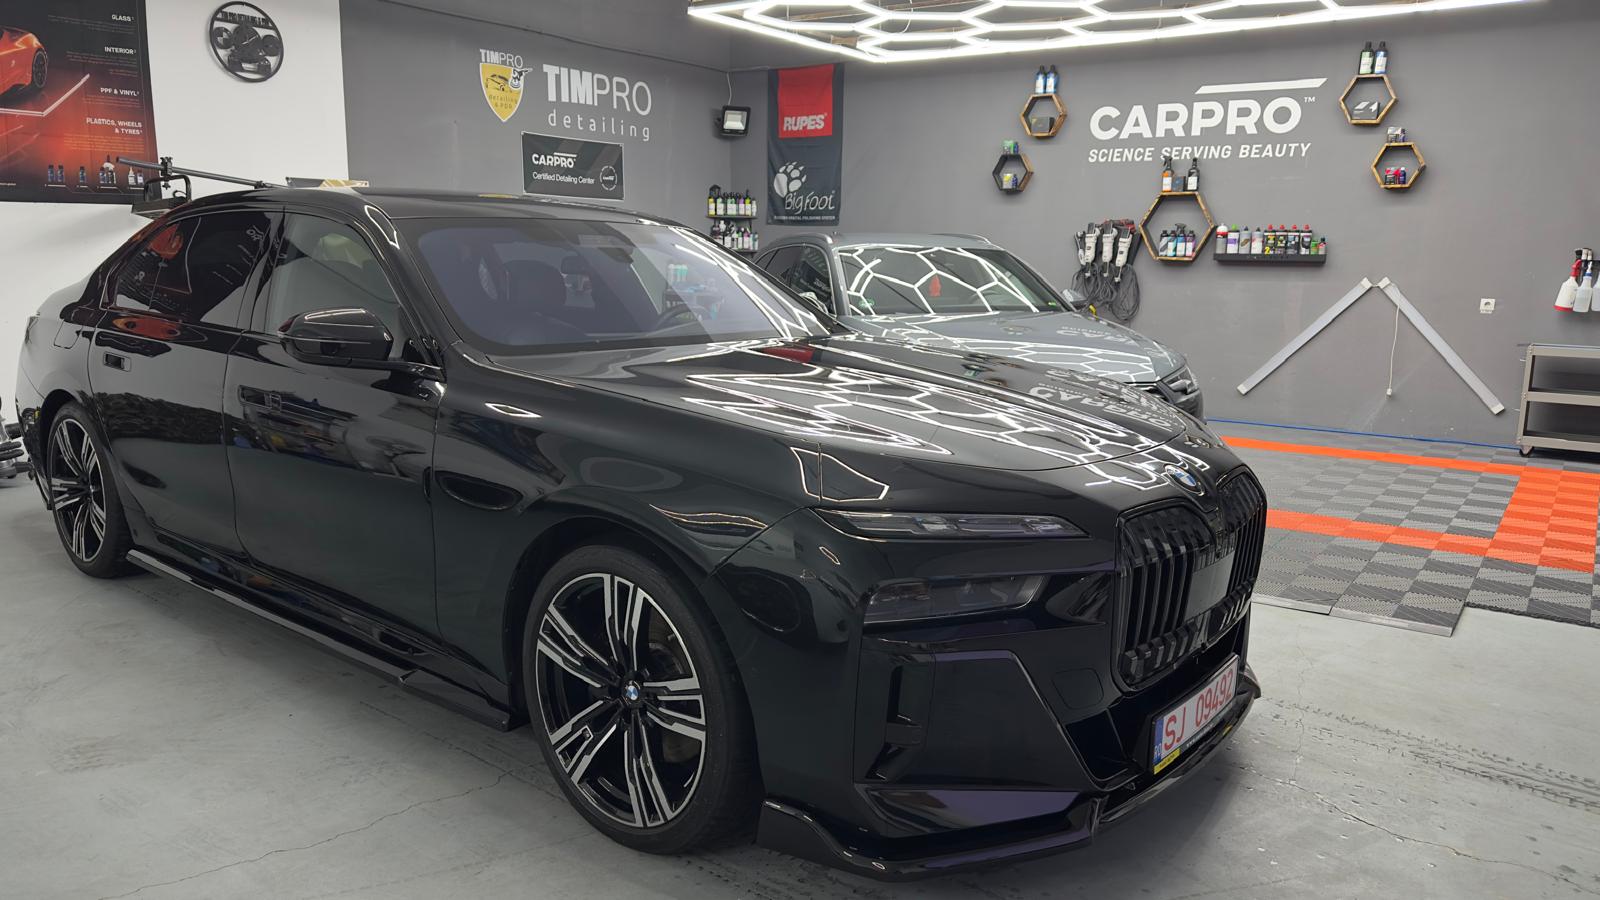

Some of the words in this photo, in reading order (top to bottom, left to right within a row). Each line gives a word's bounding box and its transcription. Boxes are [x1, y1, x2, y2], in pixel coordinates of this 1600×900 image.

[104, 46, 134, 54] INTERIOR
[480, 49, 523, 69] TIMPRO
[119, 89, 138, 97] VINYL
[543, 64, 652, 115] TIMPRO
[117, 120, 142, 128] WHEELS
[548, 109, 650, 142] detailing
[783, 114, 825, 132] RUPES
[1089, 97, 1302, 140] CARPRO
[532, 153, 575, 168] CARPRO
[1088, 147, 1155, 162] SCIENCE
[1160, 145, 1232, 161] SERVING
[1239, 142, 1312, 158] BEAUTY
[532, 171, 556, 181] Certified
[556, 173, 578, 185] Detailing
[578, 175, 595, 184] Center
[1164, 707, 1186, 751] SJ
[1195, 669, 1233, 727] 09492
